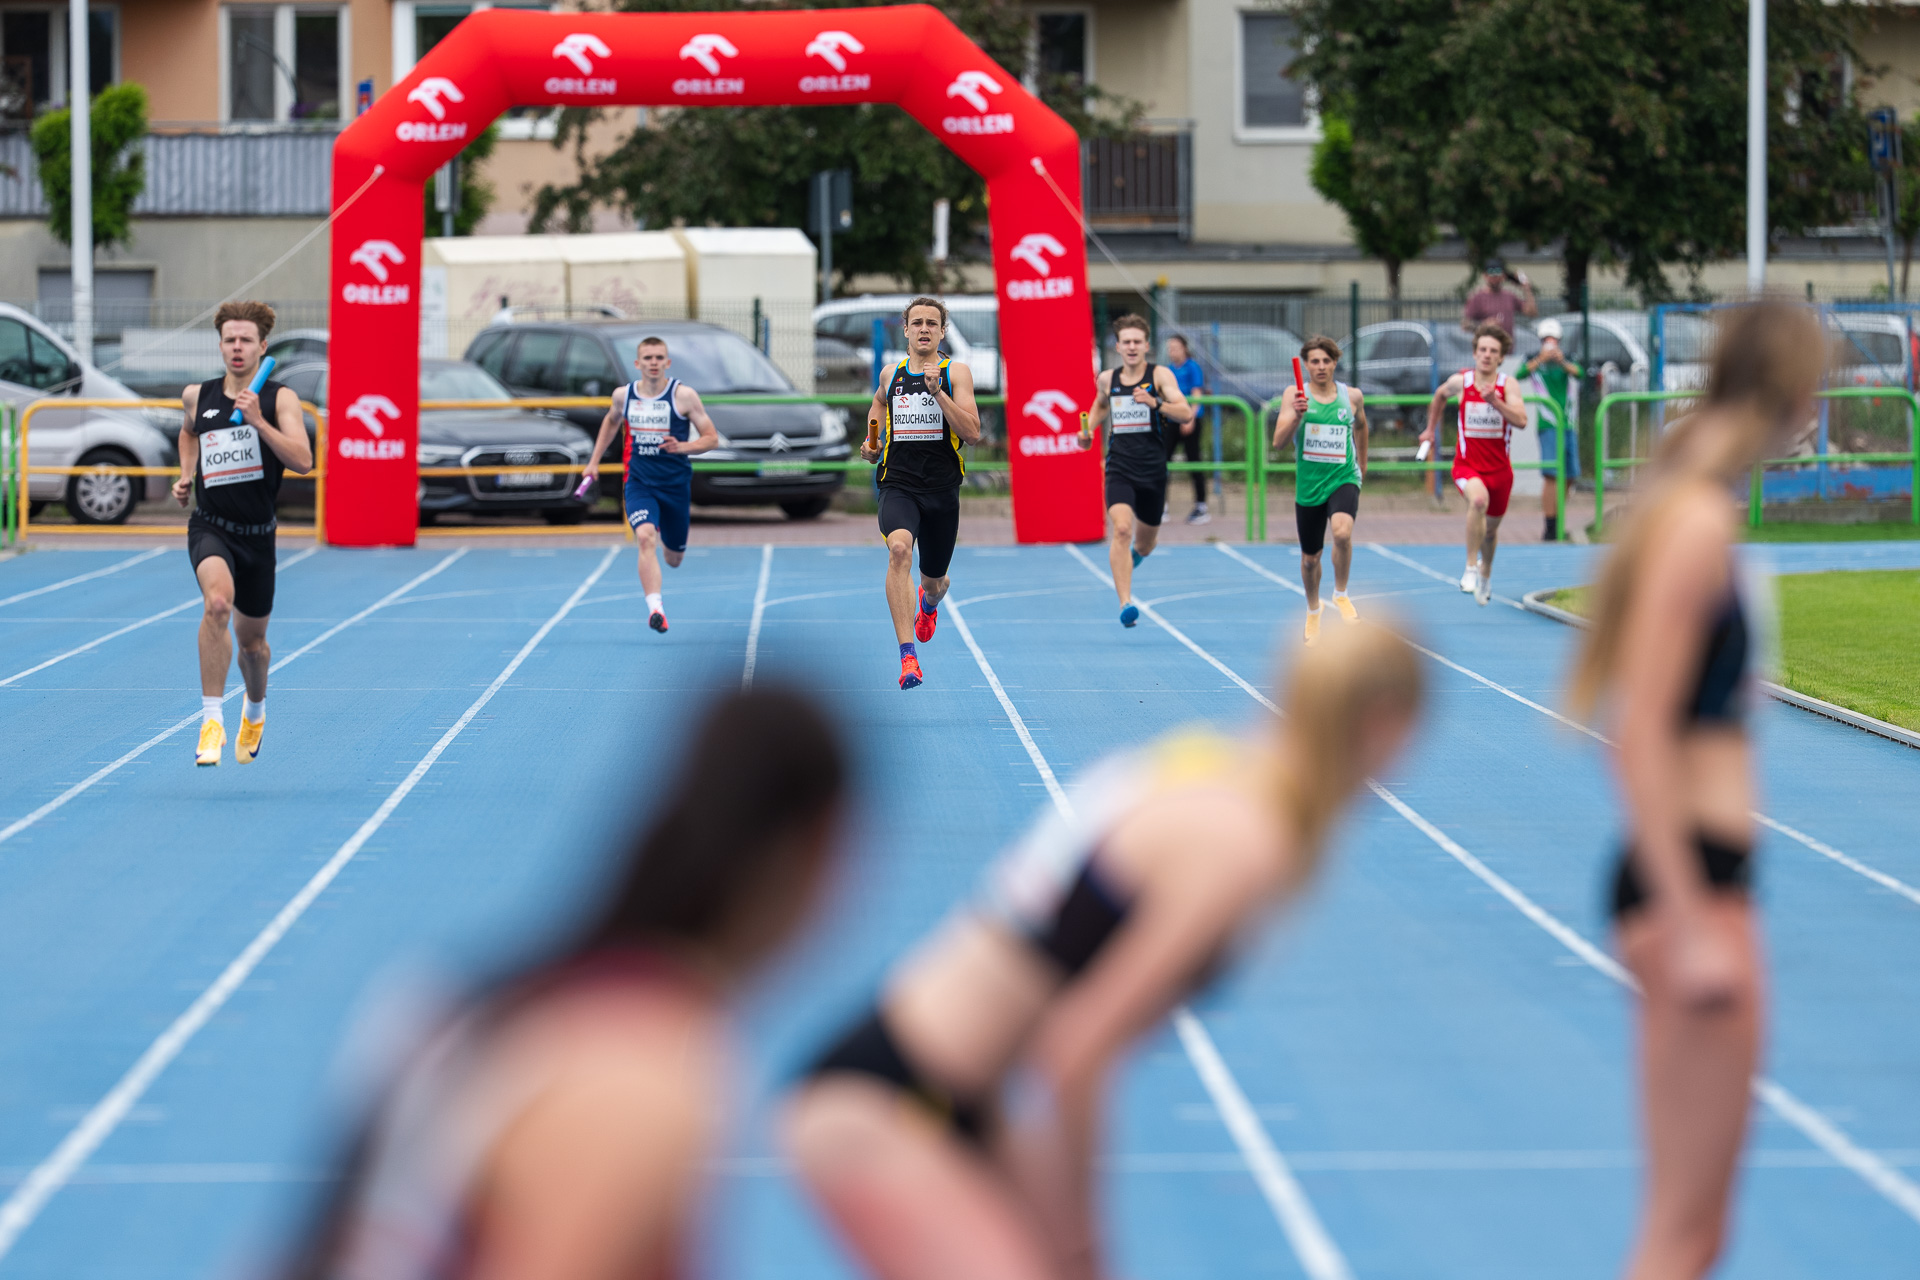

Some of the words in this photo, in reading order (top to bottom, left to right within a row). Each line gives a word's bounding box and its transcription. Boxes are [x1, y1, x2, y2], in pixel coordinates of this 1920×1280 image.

[545, 78, 616, 94] ORLEN
[673, 78, 743, 95] ORLEN
[800, 75, 870, 94] ORLEN
[396, 121, 467, 142] ORLEN
[943, 113, 1014, 135] ORLEN
[342, 284, 409, 305] ORLEN
[1006, 276, 1073, 300] ORLEN
[921, 397, 935, 407] 36
[894, 413, 941, 425] BRZUCHALSKI
[231, 428, 252, 441] 186
[1329, 427, 1344, 435] 317
[338, 438, 406, 459] ORLEN
[1018, 433, 1080, 457] ORLE
[1305, 438, 1345, 450] RUTKOWSKI
[205, 447, 254, 467] KOPCIK
